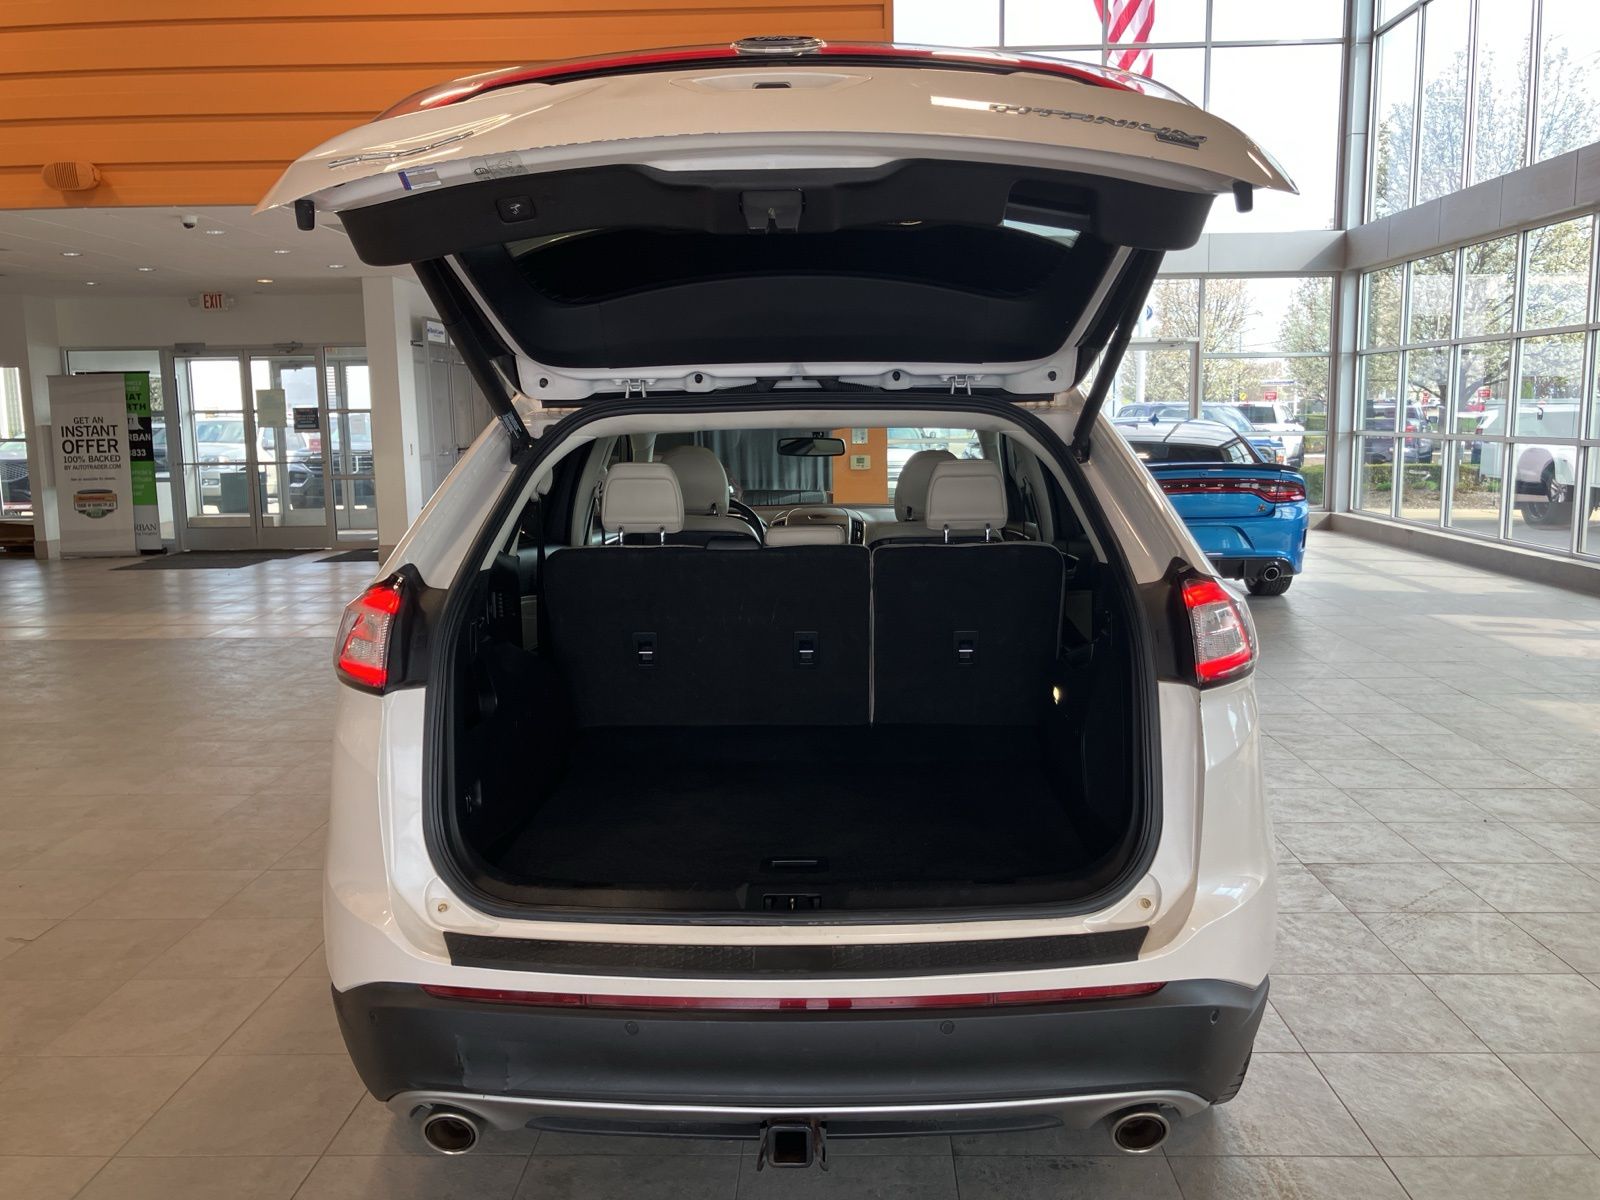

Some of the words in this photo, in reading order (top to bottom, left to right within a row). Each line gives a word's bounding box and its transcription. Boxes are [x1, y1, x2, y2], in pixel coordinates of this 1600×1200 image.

[203, 293, 222, 309] EXIT
[73, 416, 89, 424] GET
[92, 416, 104, 424] AN
[61, 425, 118, 438] INSTANT
[62, 438, 119, 454] OFFER
[88, 455, 121, 463] BACKED
